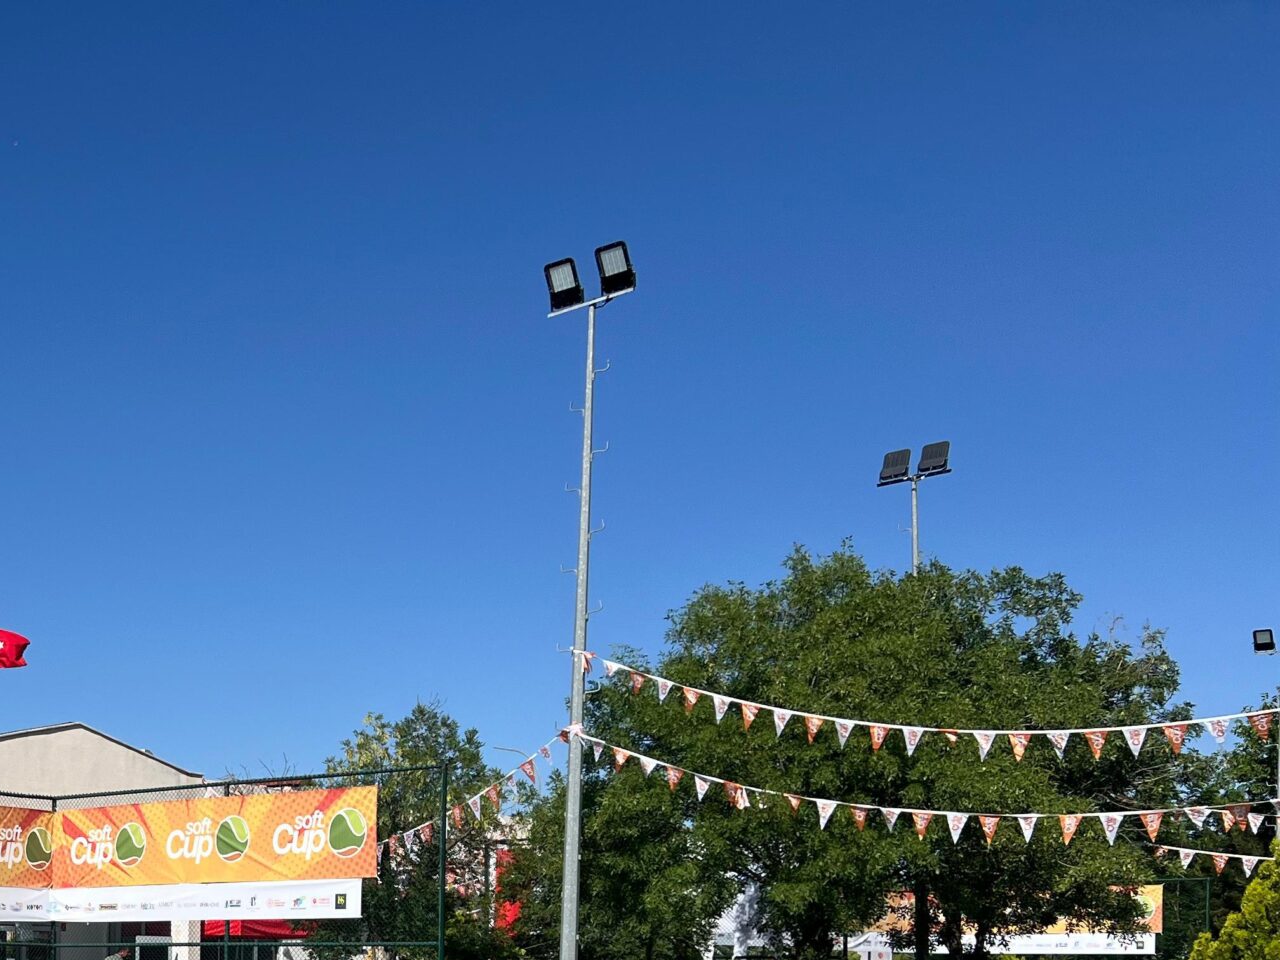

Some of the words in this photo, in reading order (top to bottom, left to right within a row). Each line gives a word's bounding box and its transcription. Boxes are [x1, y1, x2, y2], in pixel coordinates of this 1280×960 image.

[70, 836, 113, 870] Cup
[166, 829, 214, 864] Cup
[272, 823, 327, 861] Cup
